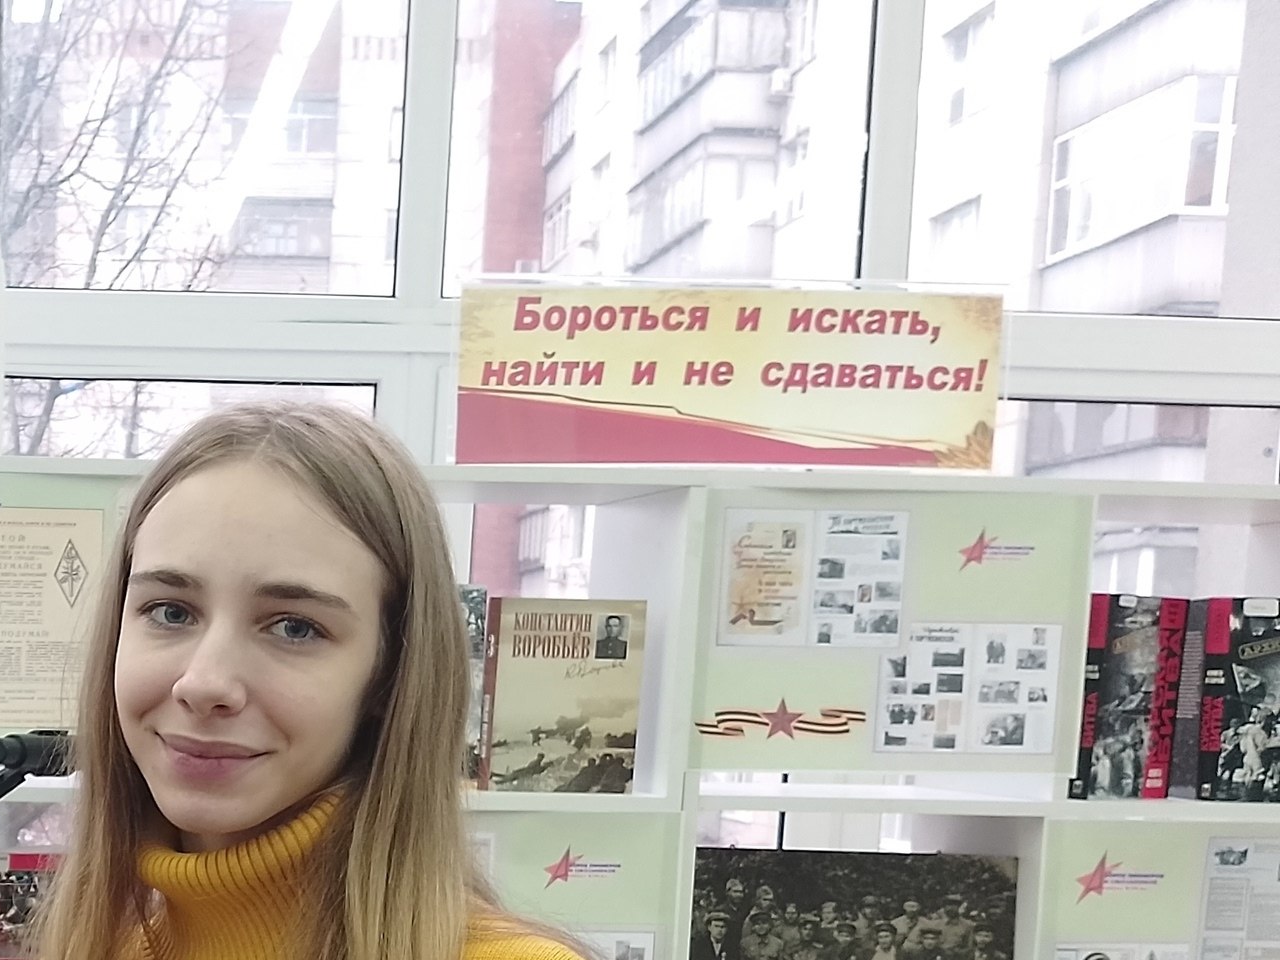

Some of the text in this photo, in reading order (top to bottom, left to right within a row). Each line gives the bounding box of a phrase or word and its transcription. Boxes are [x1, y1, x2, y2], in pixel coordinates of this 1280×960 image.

[513, 296, 941, 343] Бороться и искать,
[480, 351, 988, 393] найти и не сдаваться!
[513, 612, 593, 633] КОНСТАНТИН
[512, 632, 591, 659] ВОРОБЬЁВ
[1081, 691, 1099, 748] БИТВА
